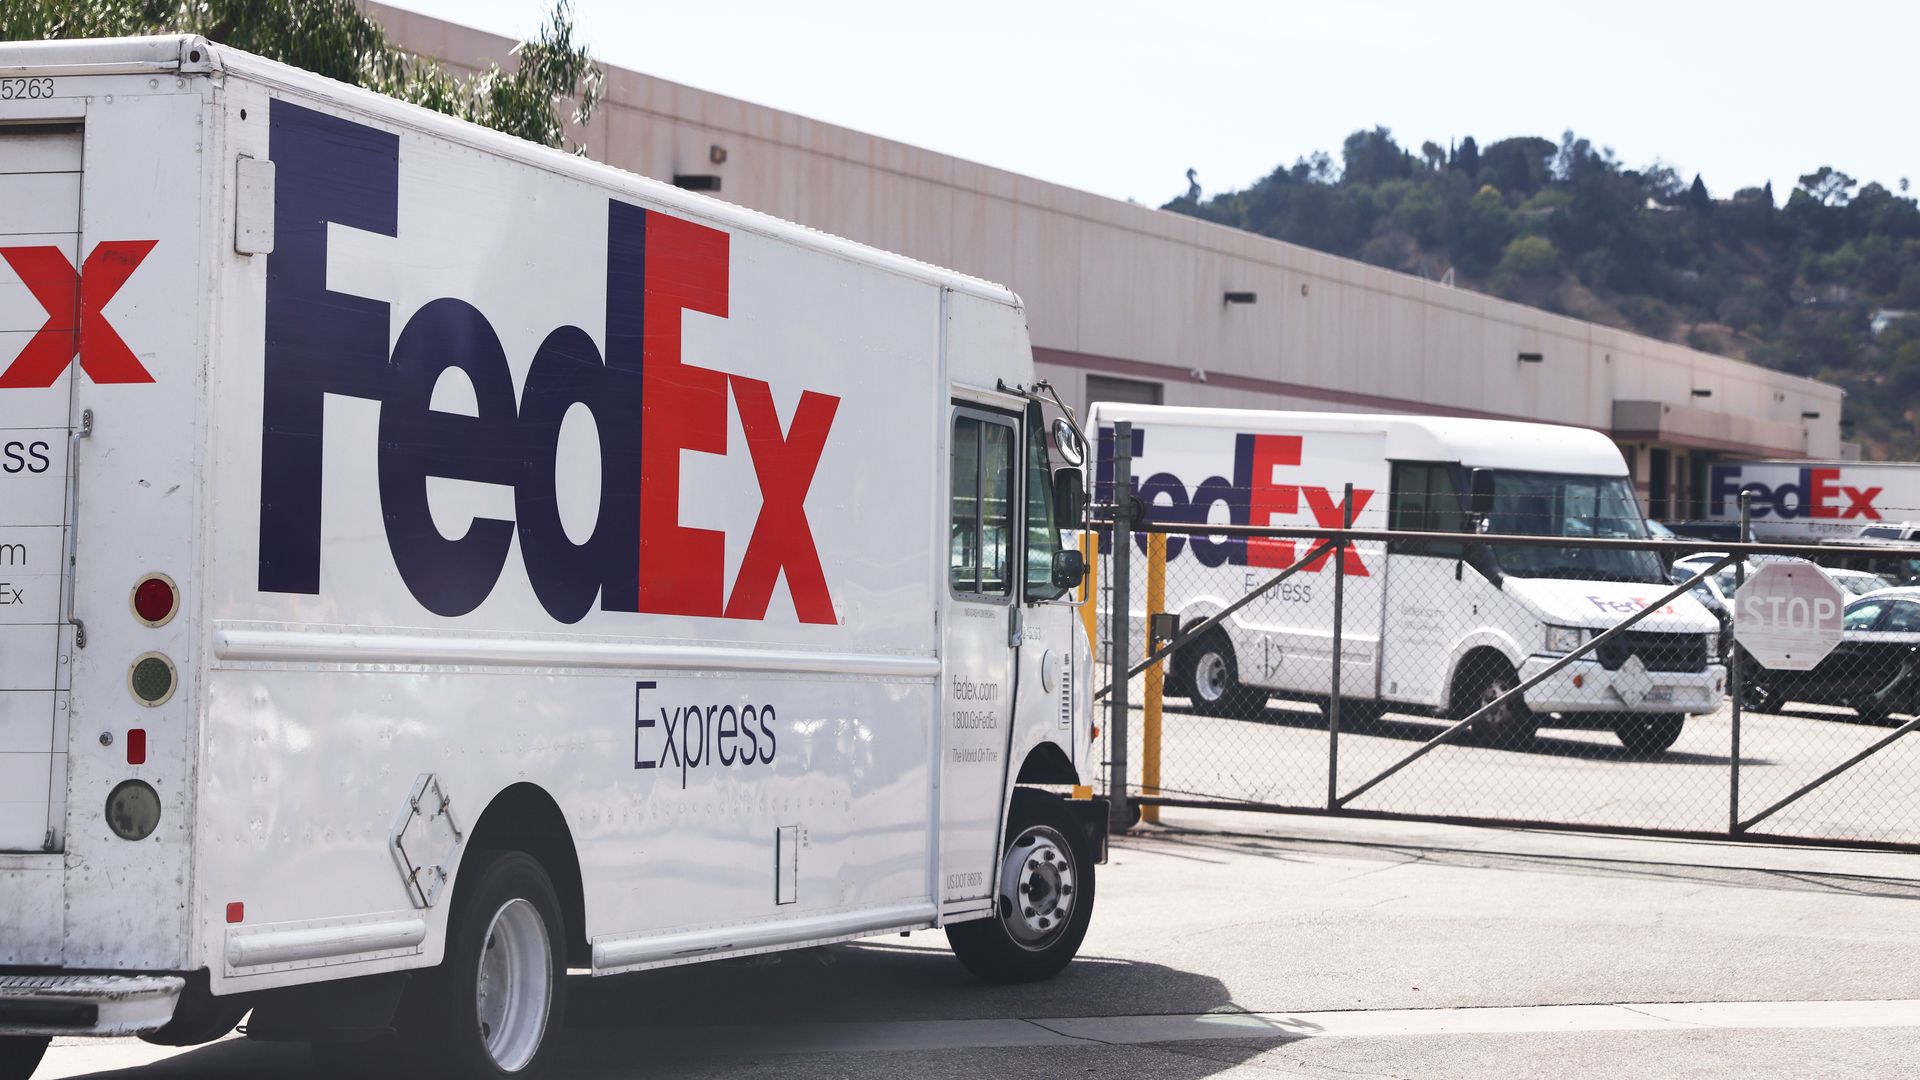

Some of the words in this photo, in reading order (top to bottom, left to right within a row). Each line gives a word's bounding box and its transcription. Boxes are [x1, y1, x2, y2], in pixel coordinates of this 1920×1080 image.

[1, 78, 54, 100] 5263
[258, 97, 841, 625] FedEx
[3, 441, 50, 474] ss
[1093, 426, 1375, 577] FedEx
[1710, 465, 1883, 520] FedEx
[1744, 596, 1836, 632] STOP
[952, 674, 998, 701] fedex.com
[634, 681, 776, 789] Express
